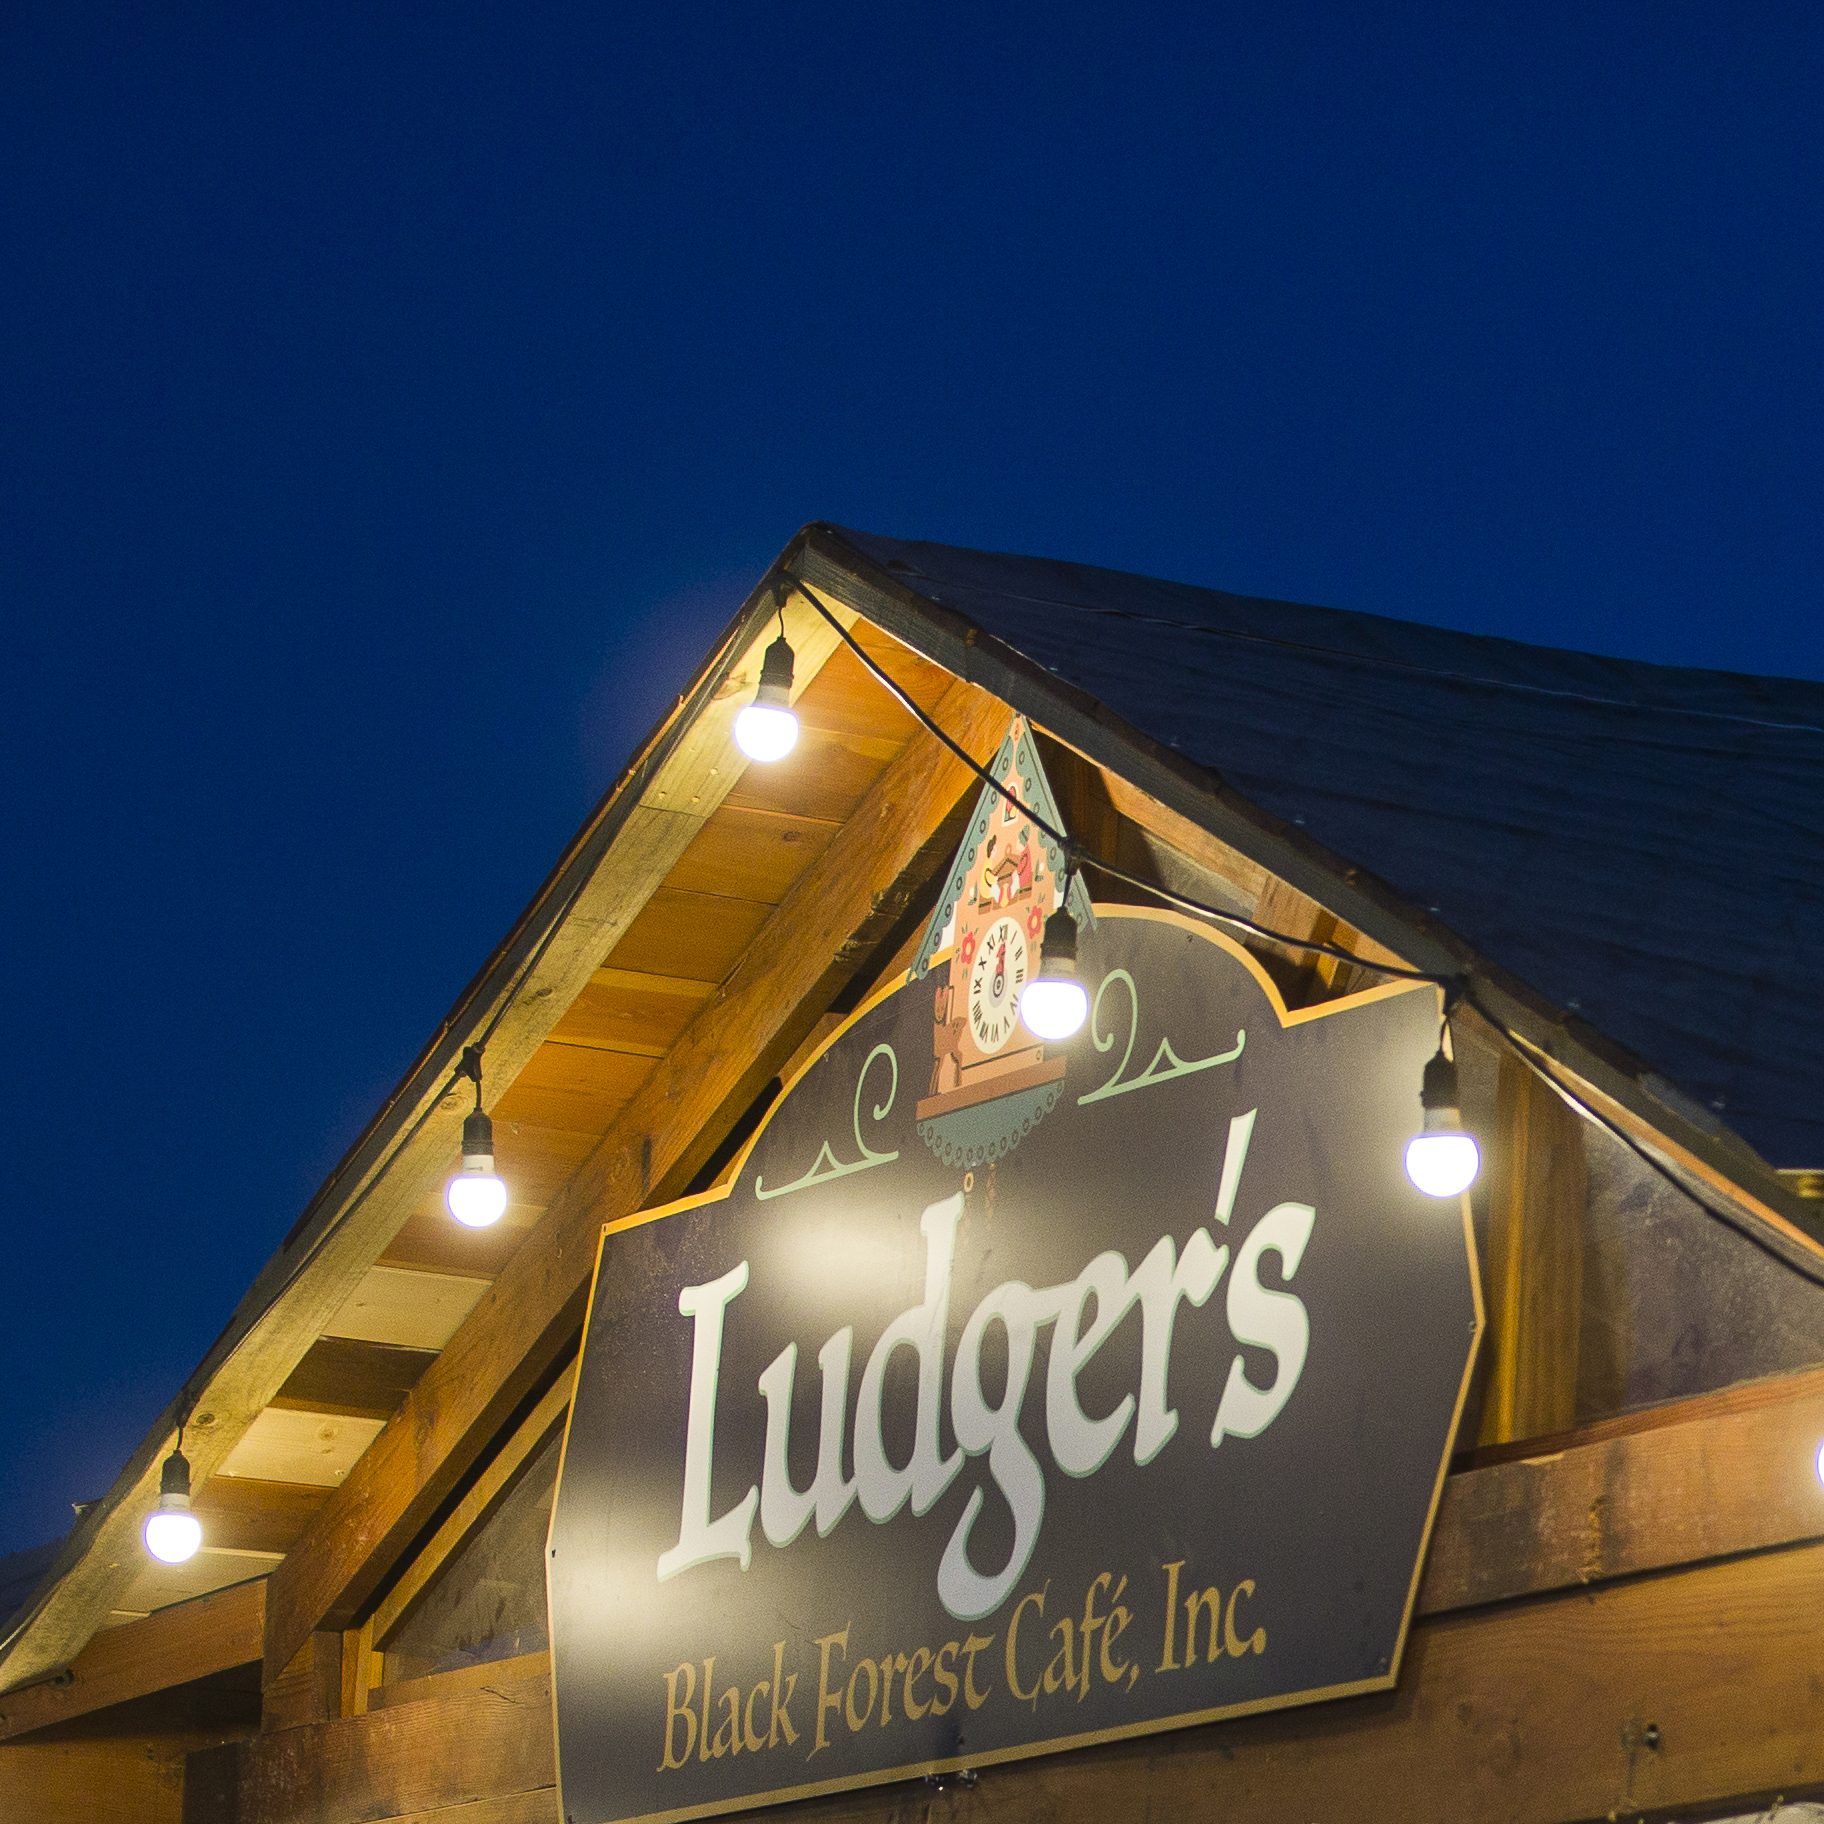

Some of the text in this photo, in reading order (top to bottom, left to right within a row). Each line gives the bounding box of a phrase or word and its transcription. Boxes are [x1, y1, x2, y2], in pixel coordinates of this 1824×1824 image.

[657, 1108, 1315, 1620] Ludger's
[656, 1560, 1266, 1771] Black Forest Café, Inc.
